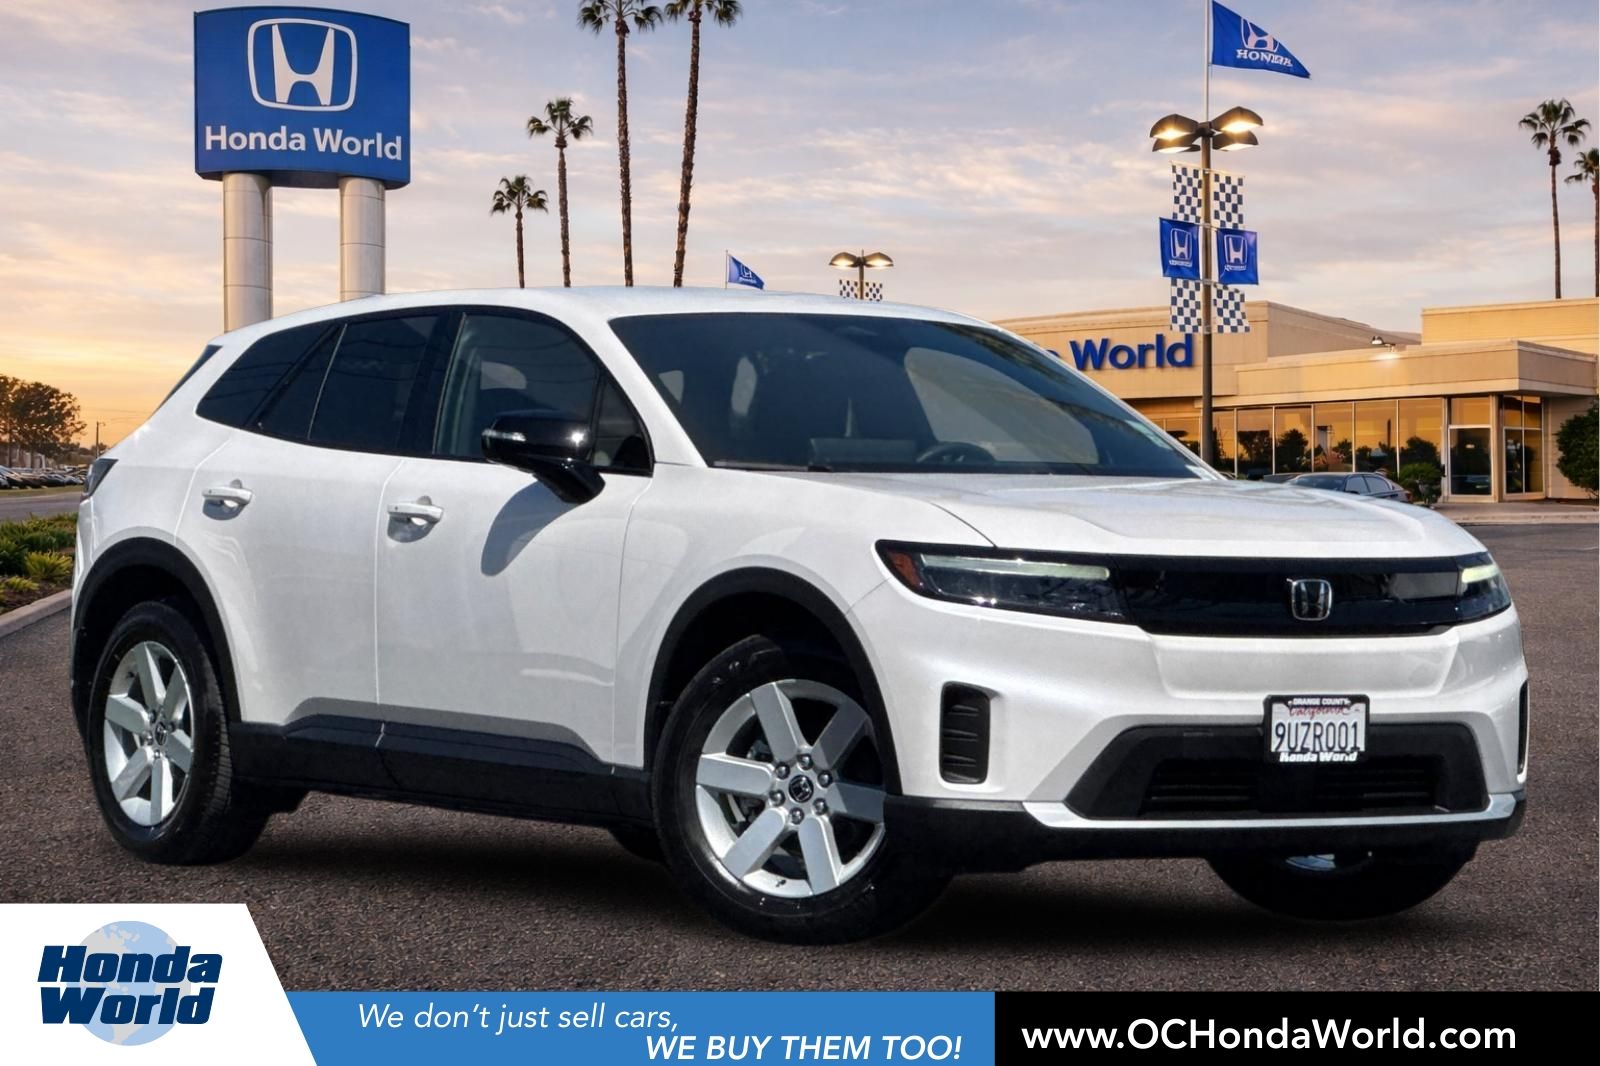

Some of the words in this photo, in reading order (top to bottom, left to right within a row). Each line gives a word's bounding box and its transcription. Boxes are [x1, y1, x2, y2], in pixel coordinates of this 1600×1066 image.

[205, 125, 306, 151] Honda
[313, 127, 402, 161] World
[1069, 333, 1194, 371] World
[1275, 721, 1360, 751] 9UZR001
[1279, 751, 1318, 762] Honda
[1320, 751, 1358, 762] World
